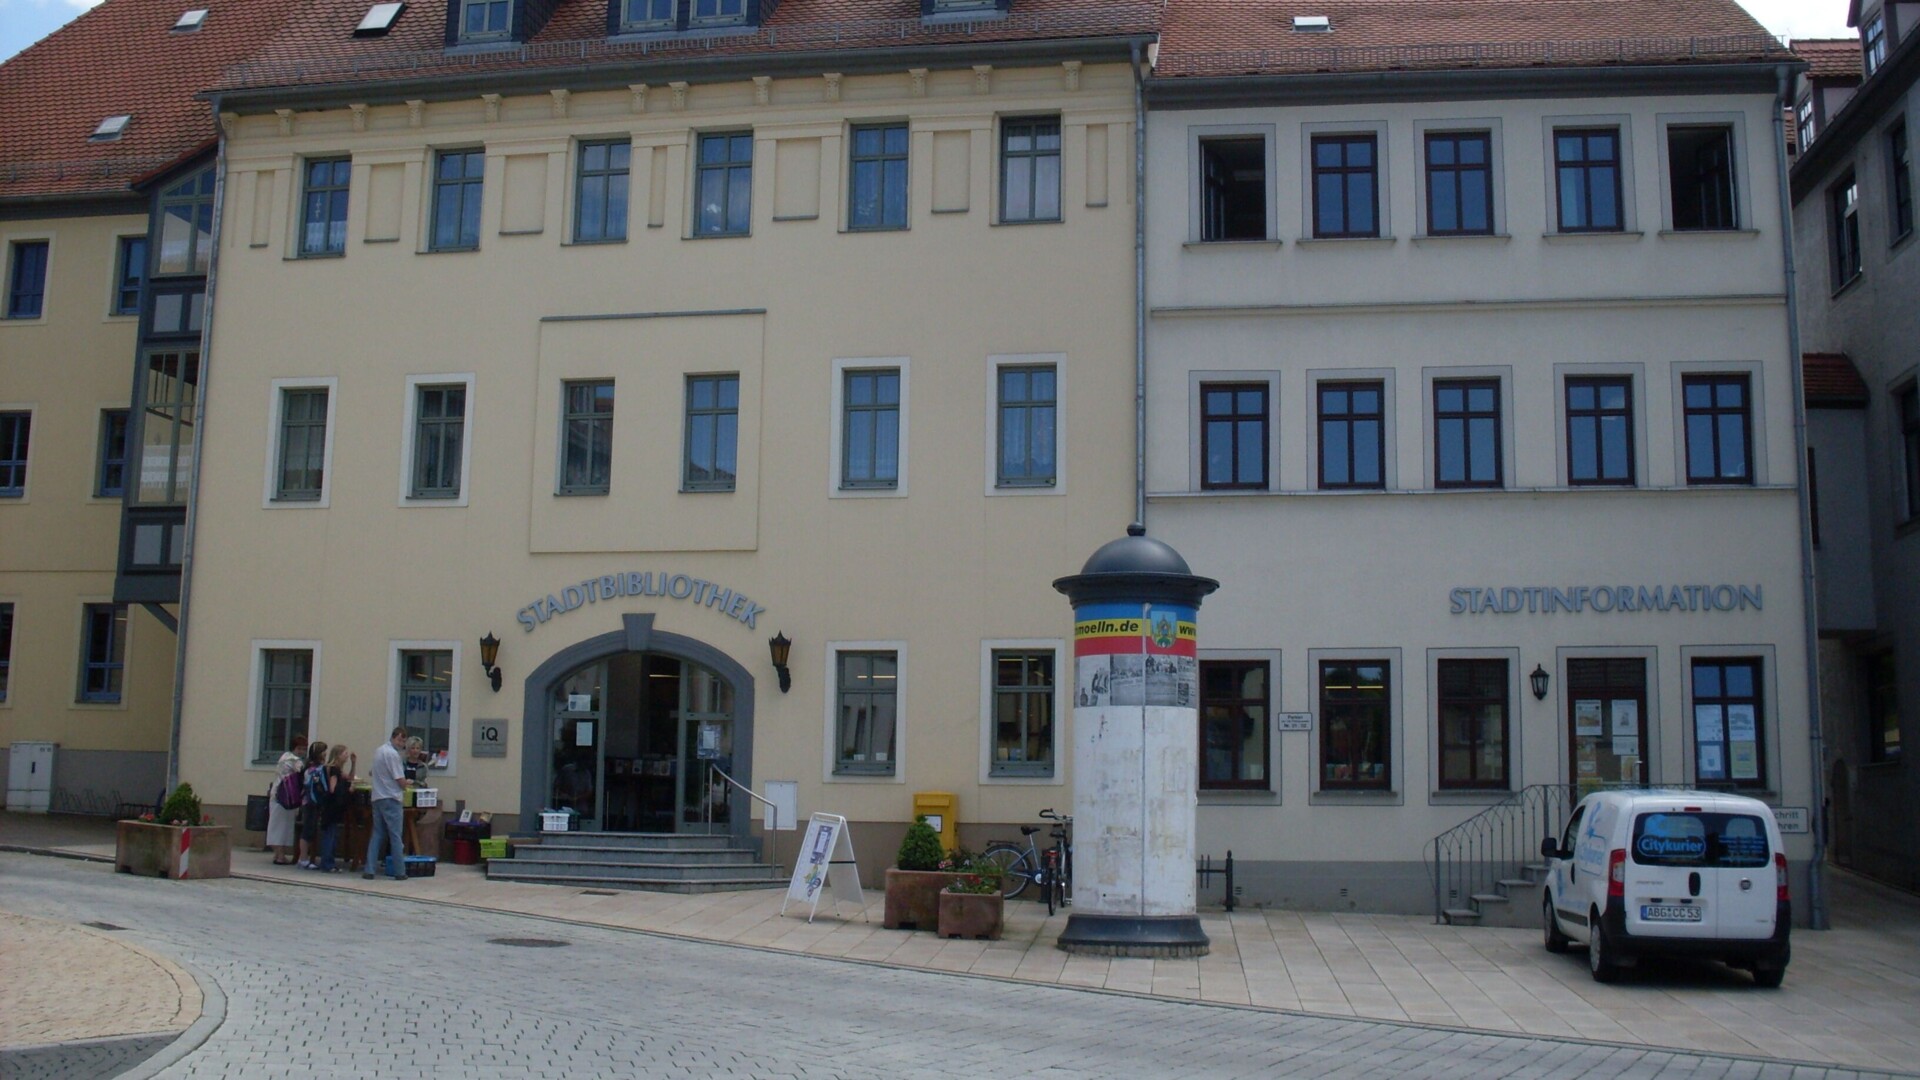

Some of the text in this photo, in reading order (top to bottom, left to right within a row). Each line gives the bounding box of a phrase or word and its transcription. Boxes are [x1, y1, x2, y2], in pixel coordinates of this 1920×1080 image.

[517, 572, 765, 633] STADTBIBLIOTHEK
[1449, 584, 1764, 614] STADTINFORMATION
[481, 726, 498, 742] iQ
[1641, 838, 1703, 853] Citykurier
[1647, 907, 1700, 919] ABG CC 53
